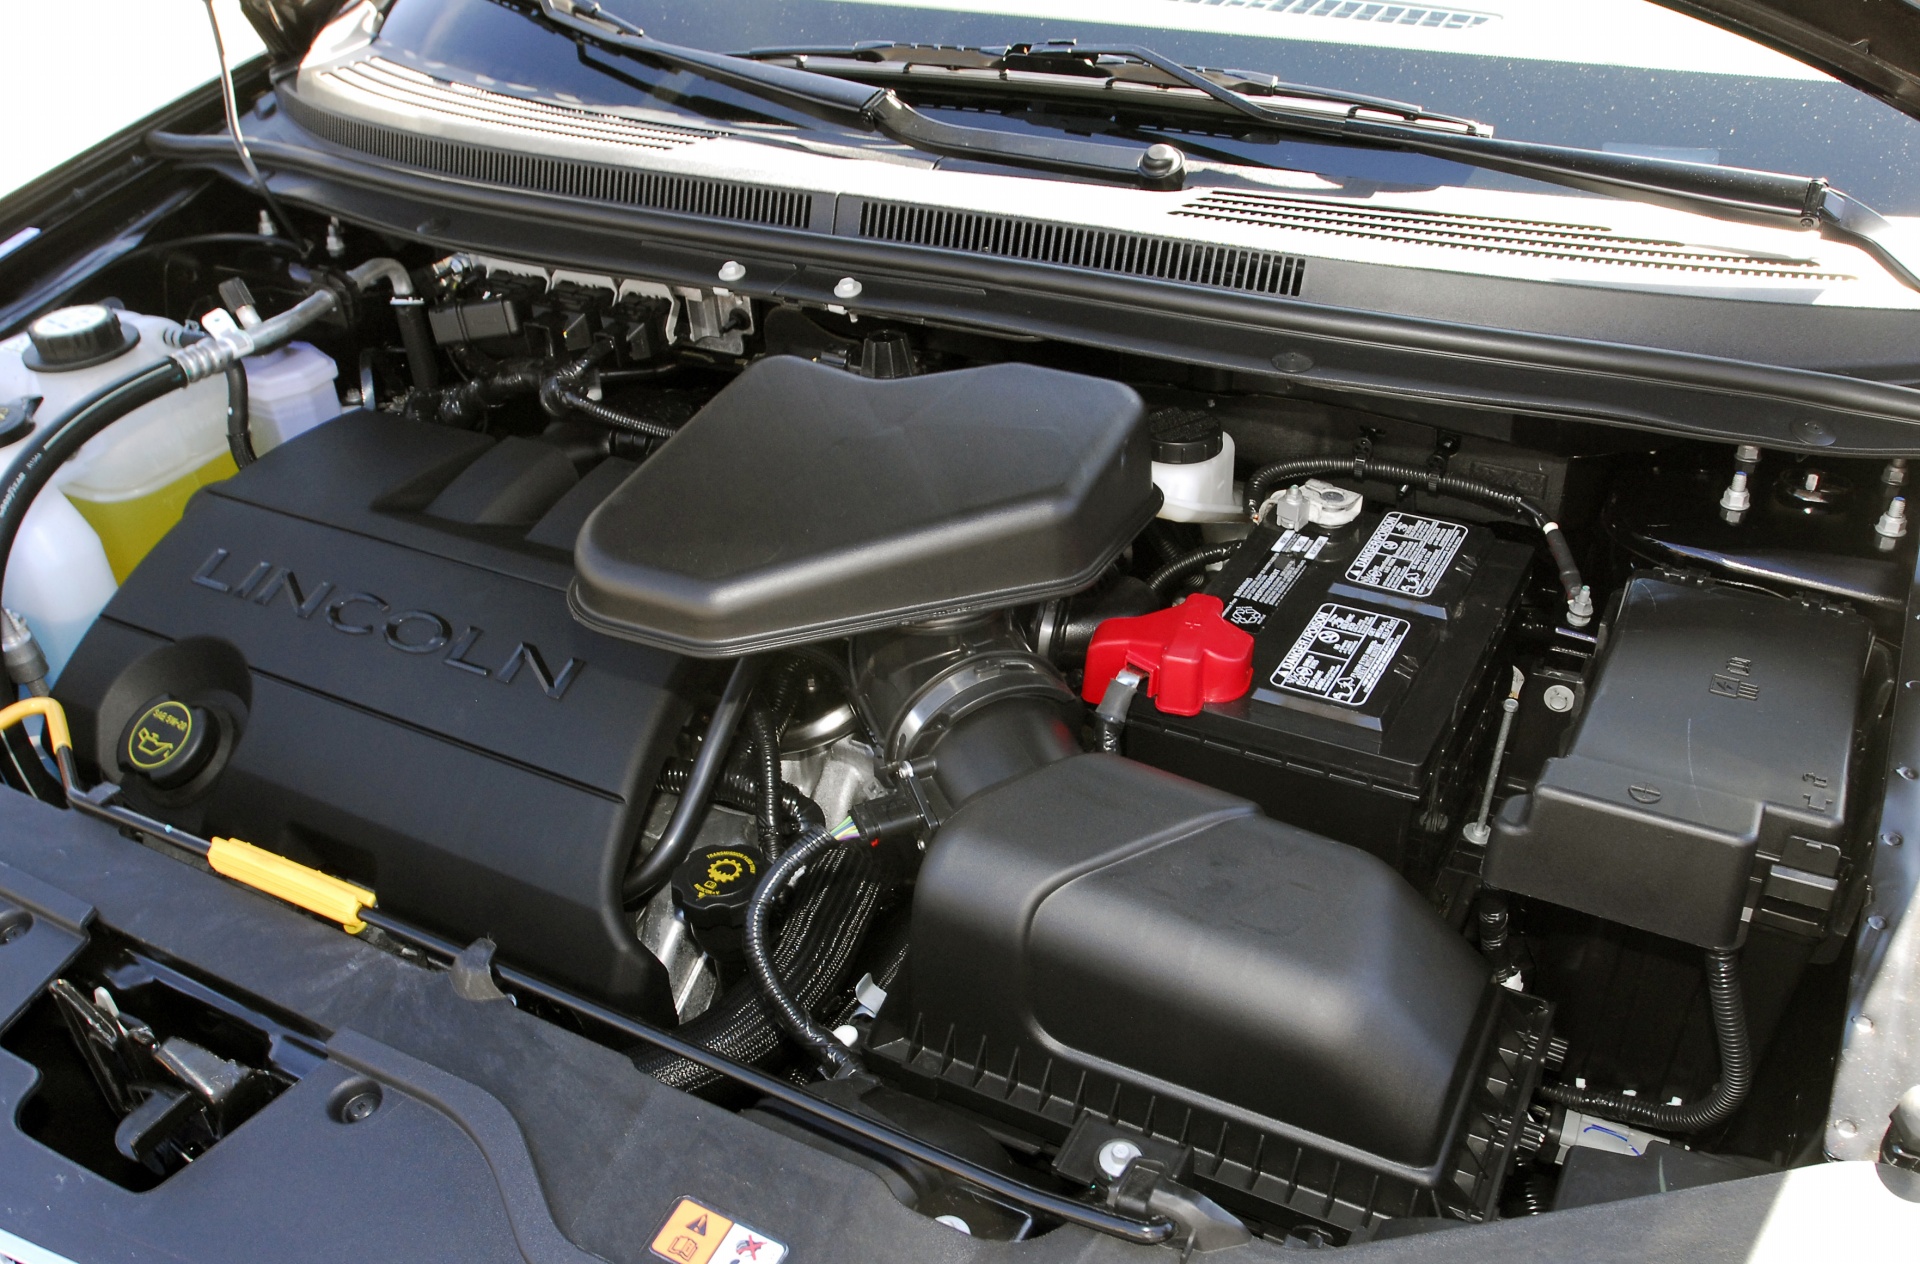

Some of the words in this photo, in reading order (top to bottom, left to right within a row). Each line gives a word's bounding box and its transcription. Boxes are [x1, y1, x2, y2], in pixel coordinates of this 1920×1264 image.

[191, 547, 587, 699] LINCOLN
[1282, 611, 1329, 670] DANGER/POISON
[706, 850, 744, 859] TRANSMISSION
